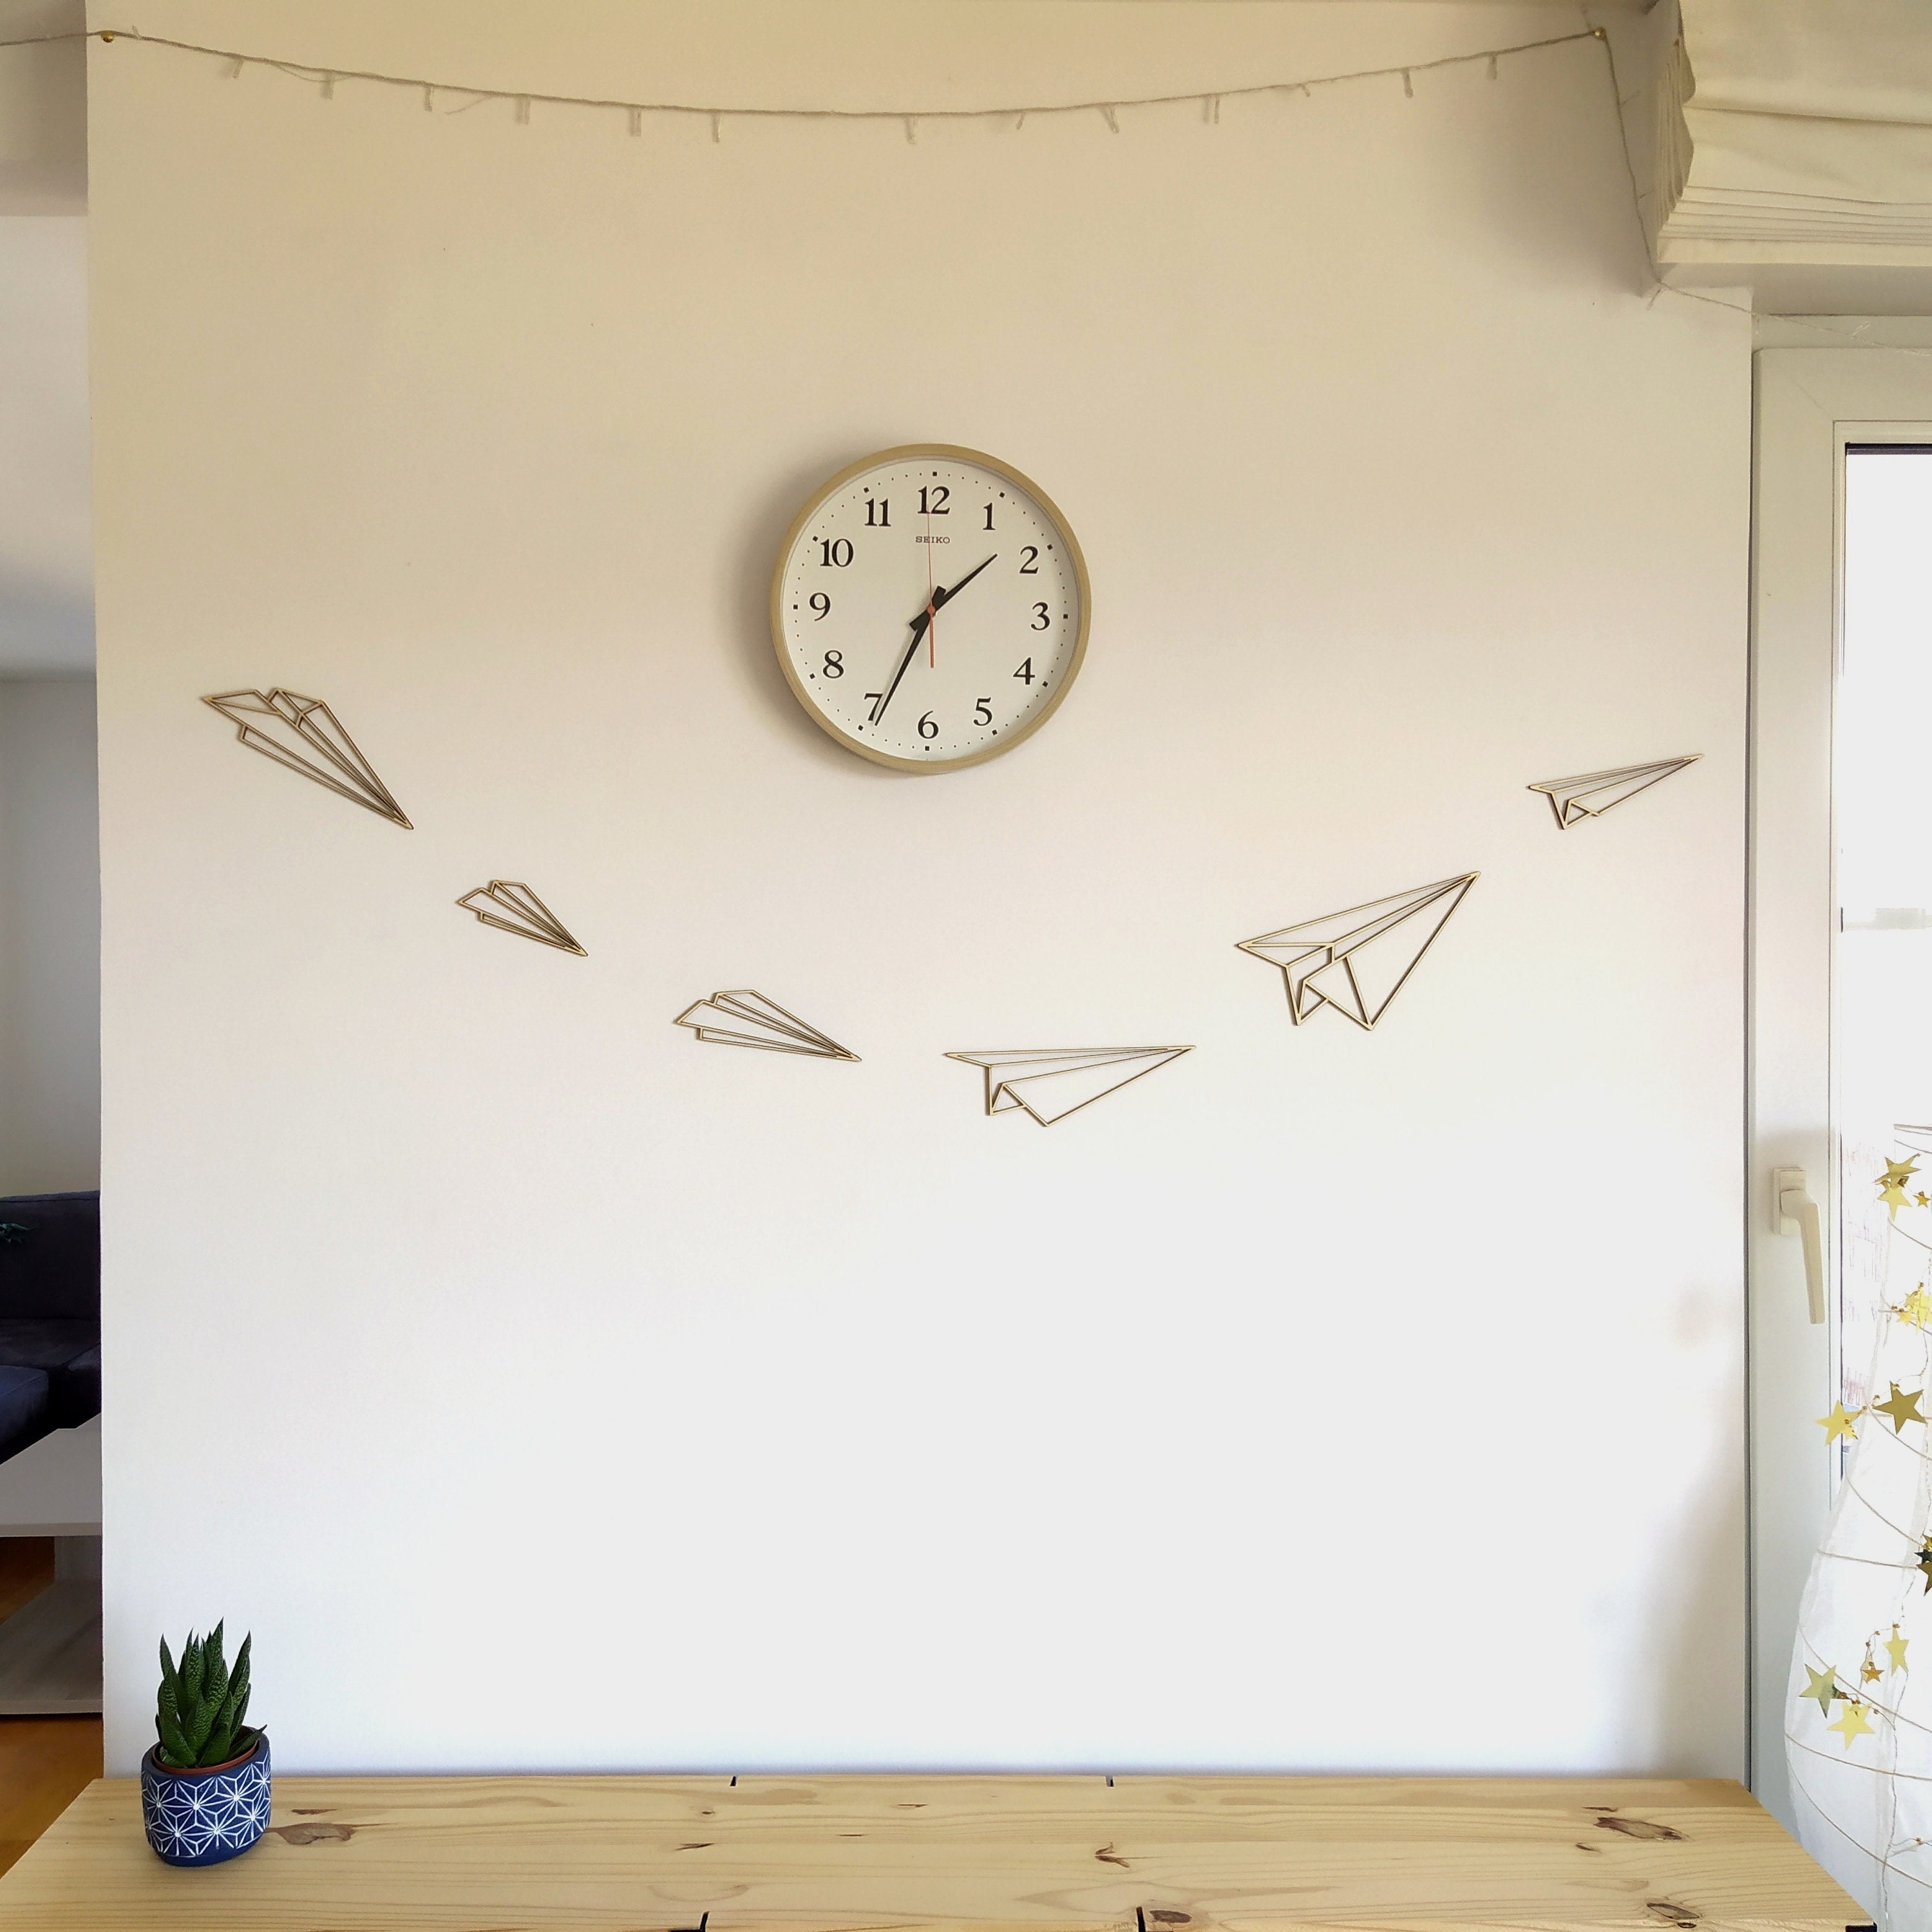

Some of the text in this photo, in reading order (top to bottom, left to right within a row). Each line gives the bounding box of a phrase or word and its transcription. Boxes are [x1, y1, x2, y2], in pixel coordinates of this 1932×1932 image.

[864, 497, 892, 527] 11
[917, 485, 951, 515] 12
[983, 502, 996, 531] 1
[819, 538, 855, 567] 10
[915, 536, 951, 544] SEIKO
[1019, 545, 1039, 575] 2
[809, 592, 831, 621] 9
[1030, 601, 1051, 632] 3
[822, 650, 845, 679] 8
[1012, 657, 1036, 686] 4
[864, 692, 884, 721] 7
[973, 697, 993, 726] 5
[918, 710, 939, 739] 6
